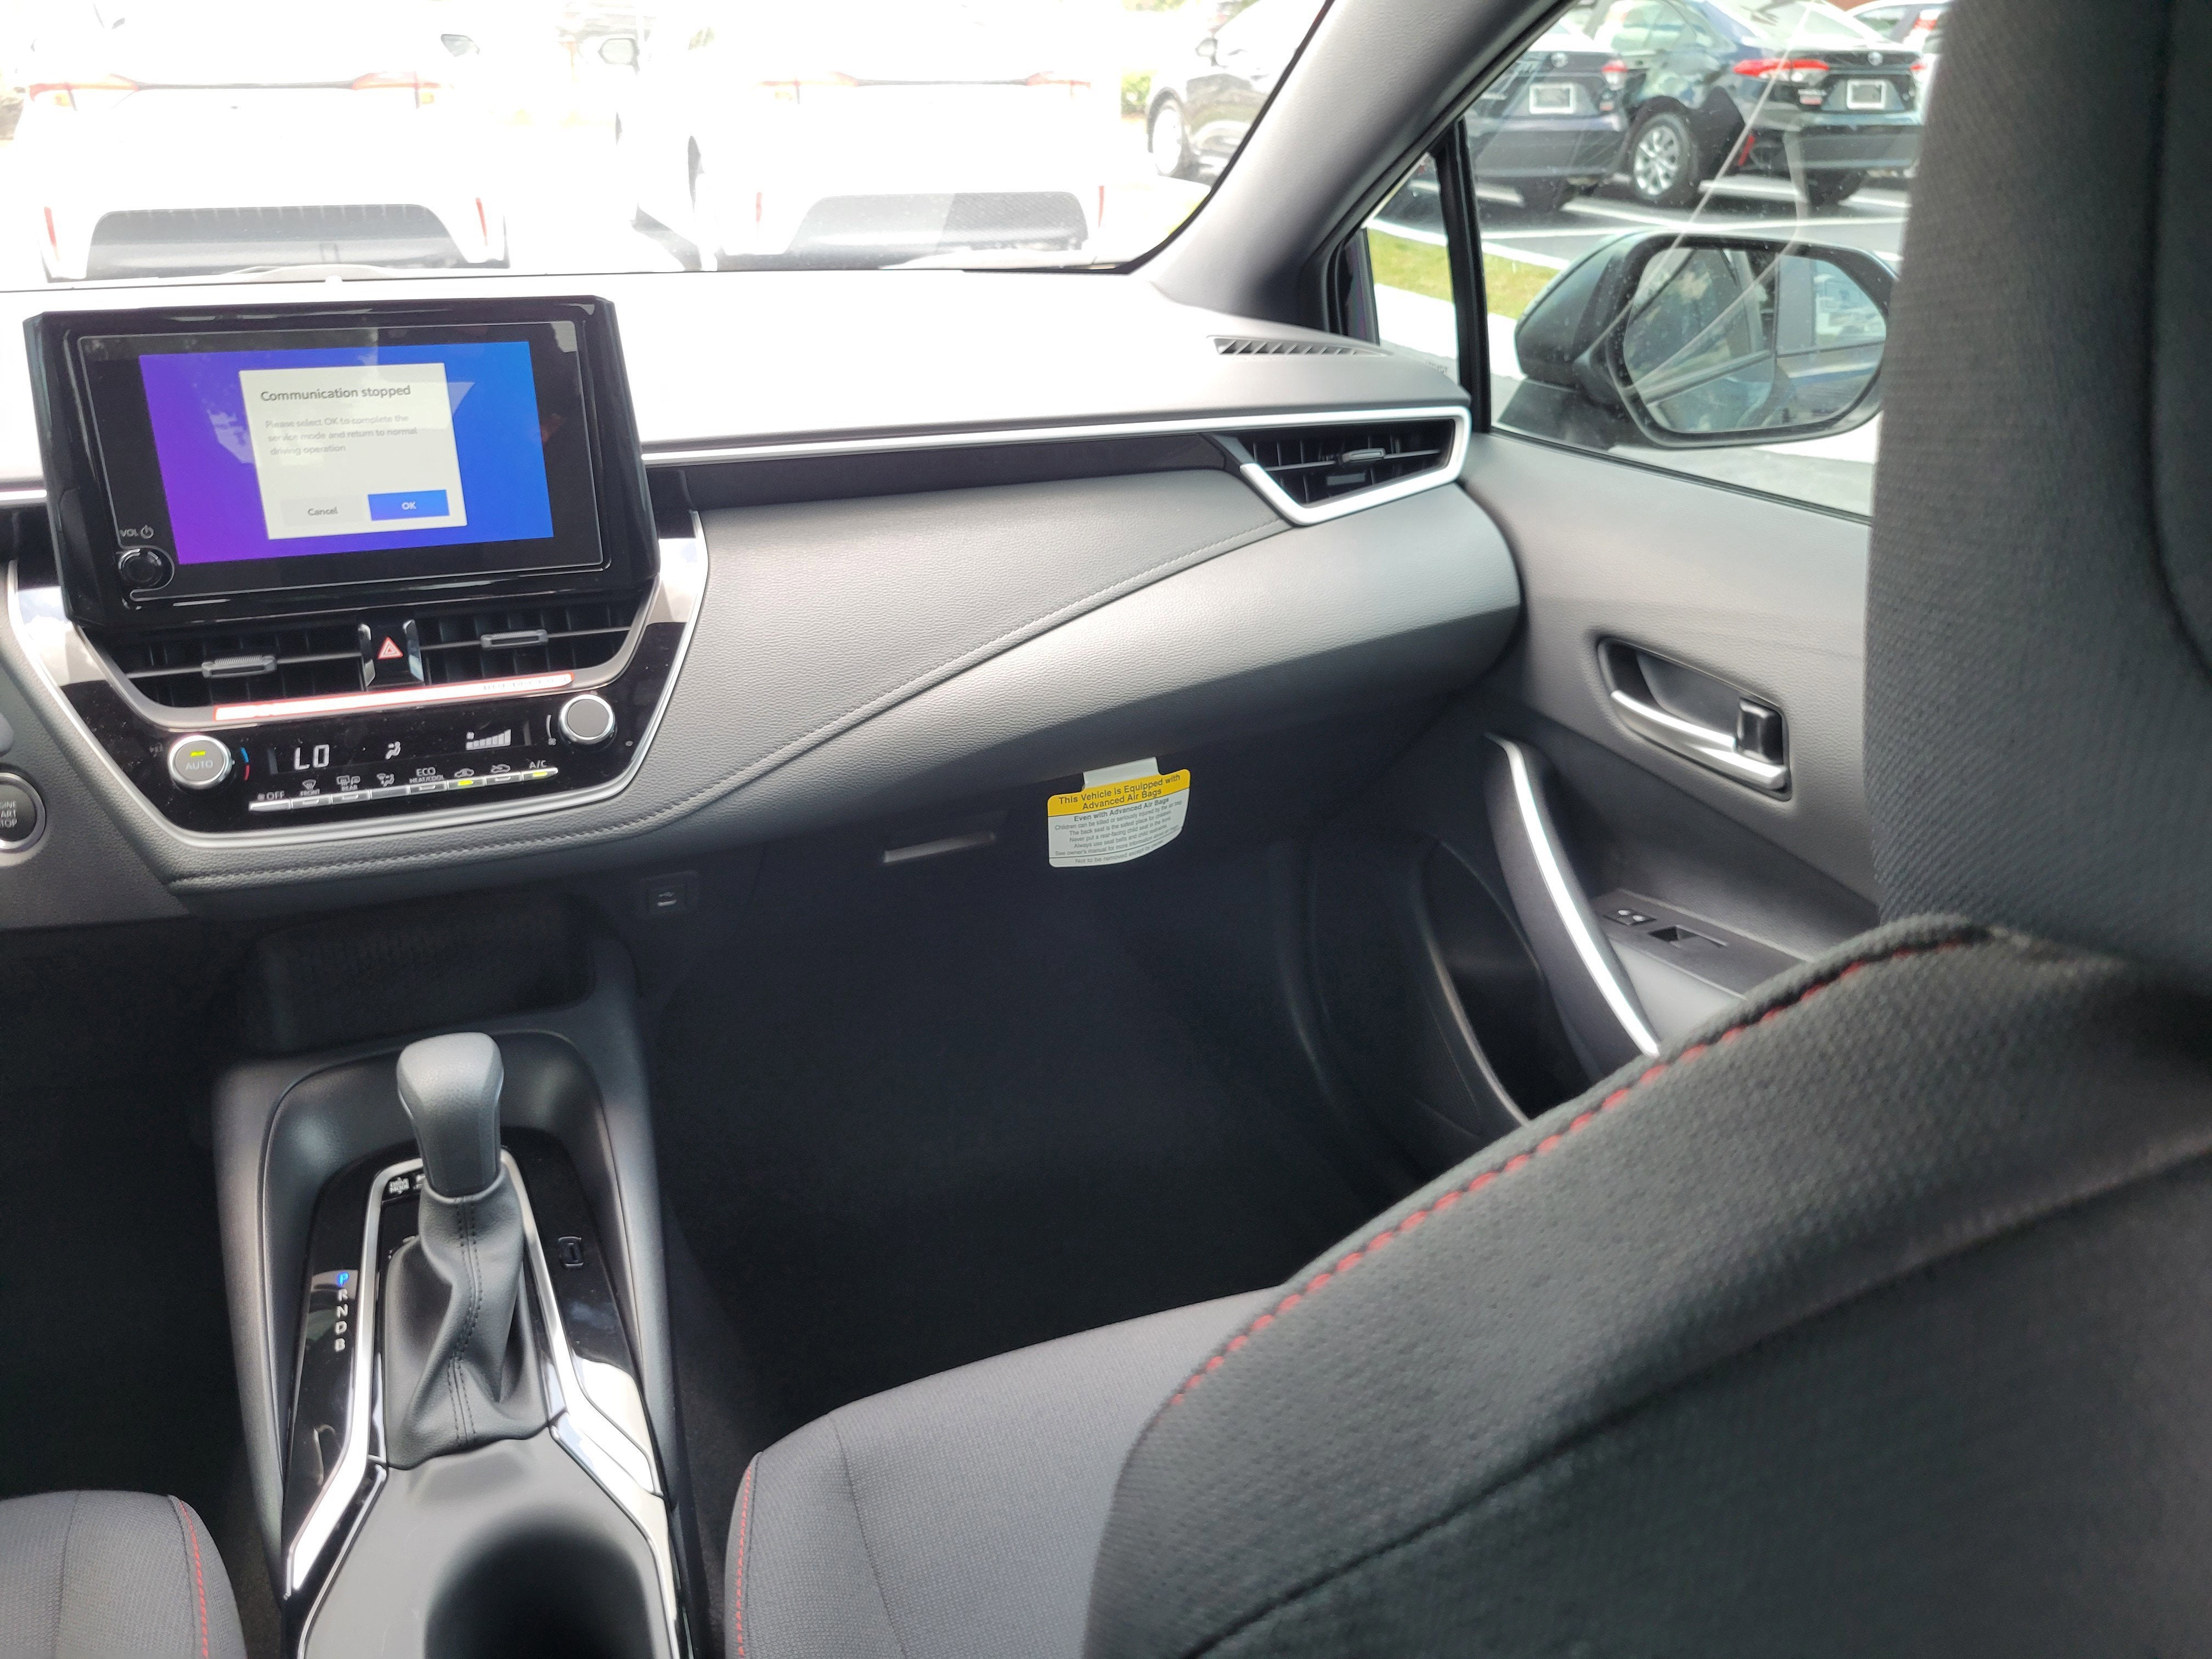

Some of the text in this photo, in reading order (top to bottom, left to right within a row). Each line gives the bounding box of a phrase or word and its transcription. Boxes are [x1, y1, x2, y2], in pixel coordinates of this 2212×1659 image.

[261, 385, 411, 402] Communication stopped
[265, 414, 409, 429] Please select OK to complete the
[300, 430, 326, 440] mode
[329, 429, 346, 439] and
[347, 428, 374, 438] return
[376, 428, 385, 437] to
[386, 426, 417, 436] normal
[270, 444, 346, 456] driving operation
[308, 506, 338, 516] Cancel
[401, 501, 417, 510] OK
[120, 528, 139, 537] VOL
[294, 744, 330, 770] LO
[529, 759, 548, 769] A/C
[186, 759, 213, 771] AUTO
[415, 766, 436, 777] ECO
[266, 790, 285, 800] OFF
[1059, 796, 1078, 804] This
[1081, 789, 1111, 801] Vehicle
[1124, 778, 1163, 793] Equipped
[1165, 774, 1181, 784] with
[1082, 789, 1162, 810] Advanced Air Bags
[1074, 814, 1091, 822] Even
[1109, 804, 1142, 816] Advanced
[1154, 797, 1169, 807] Bags
[337, 1272, 349, 1286] P
[337, 1288, 348, 1302] R
[336, 1304, 348, 1318] N
[335, 1321, 347, 1335] D
